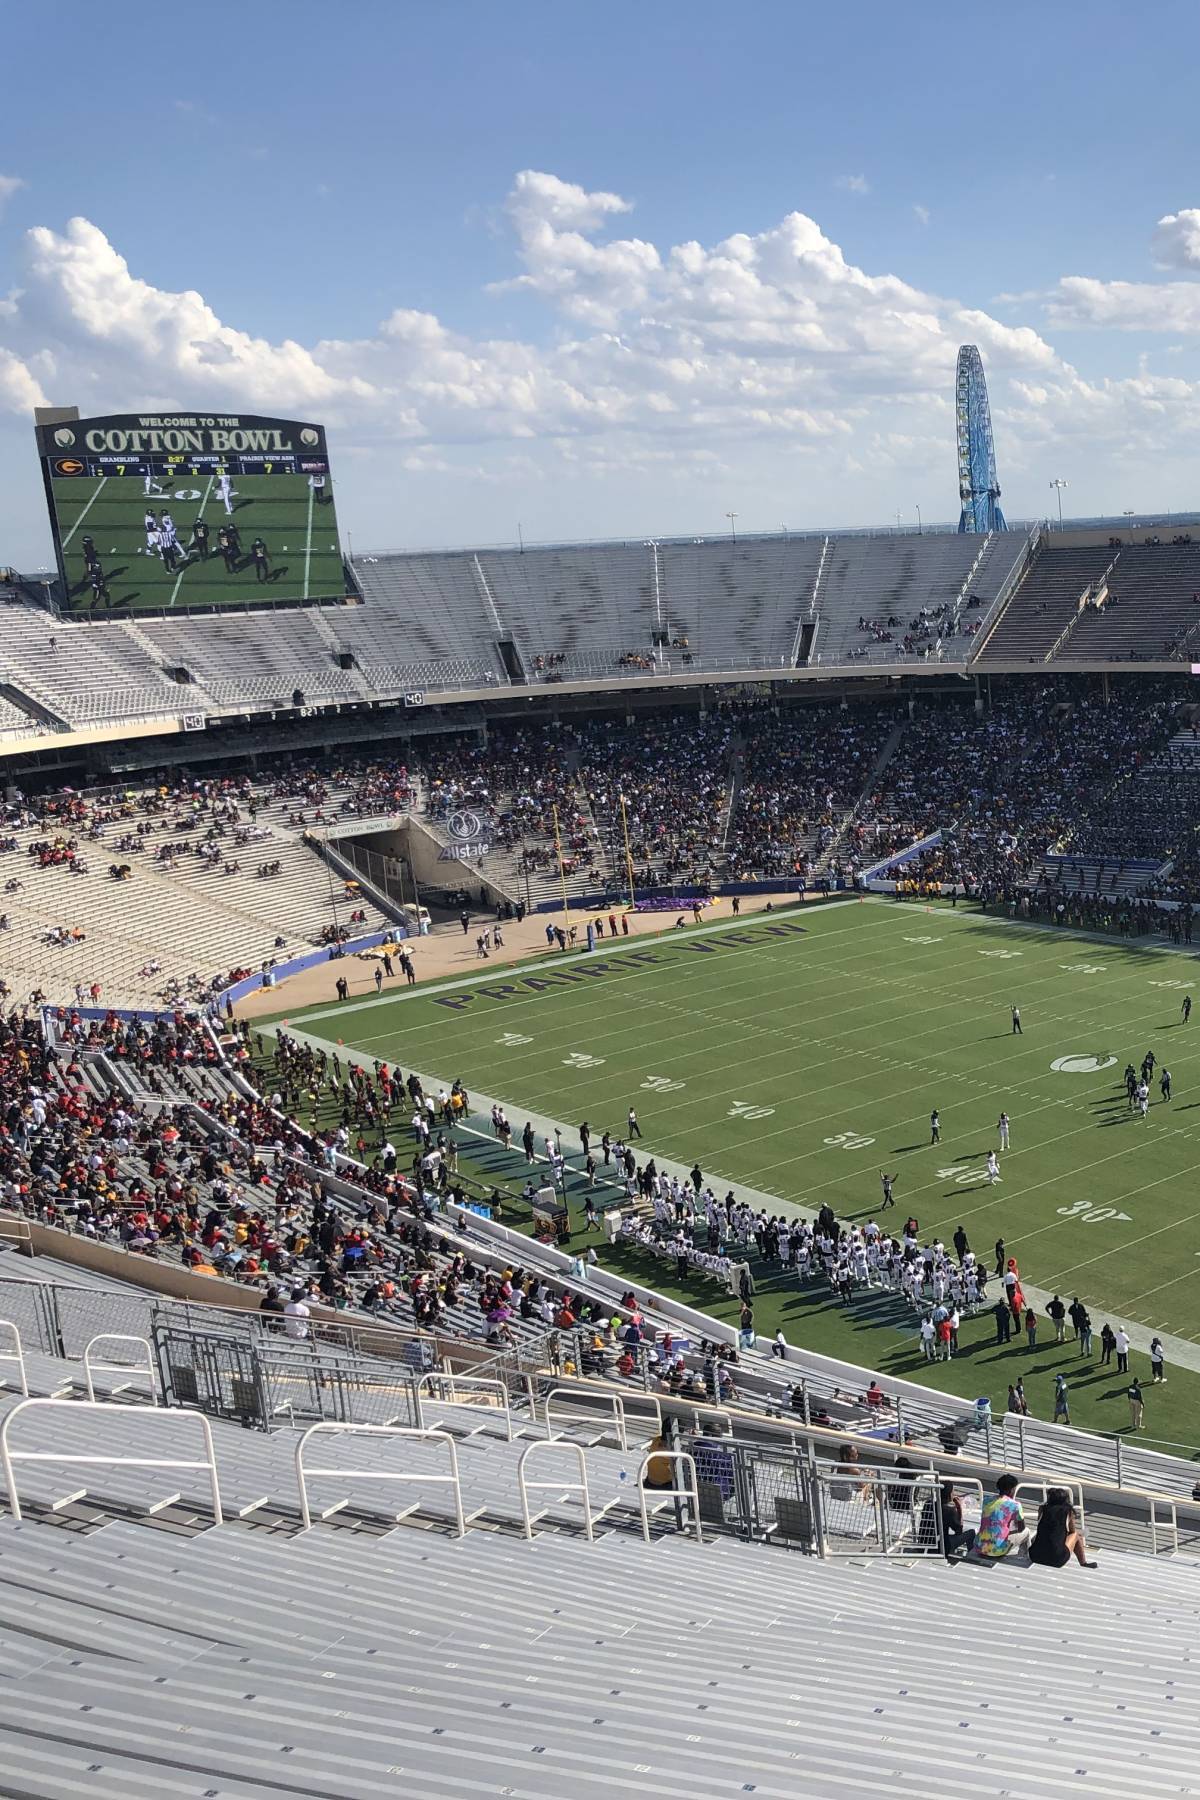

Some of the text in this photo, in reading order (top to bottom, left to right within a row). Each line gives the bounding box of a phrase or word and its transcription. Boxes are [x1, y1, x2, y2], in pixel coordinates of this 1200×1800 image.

[139, 417, 239, 427] WELCOME TO THE
[85, 429, 292, 452] COTTON BOWL
[116, 465, 125, 476] 7
[264, 463, 273, 474] 7
[406, 693, 421, 704] 40
[186, 715, 202, 728] 40
[439, 842, 489, 860] Allstate
[431, 921, 810, 1012] PRAIRIE VIEW
[493, 1034, 534, 1046] 10
[560, 1056, 607, 1069] 20
[639, 1078, 687, 1093] 30
[726, 1105, 776, 1120] 40
[823, 1132, 877, 1150] 50
[935, 1165, 990, 1184] 40
[1056, 1200, 1118, 1223] 30
